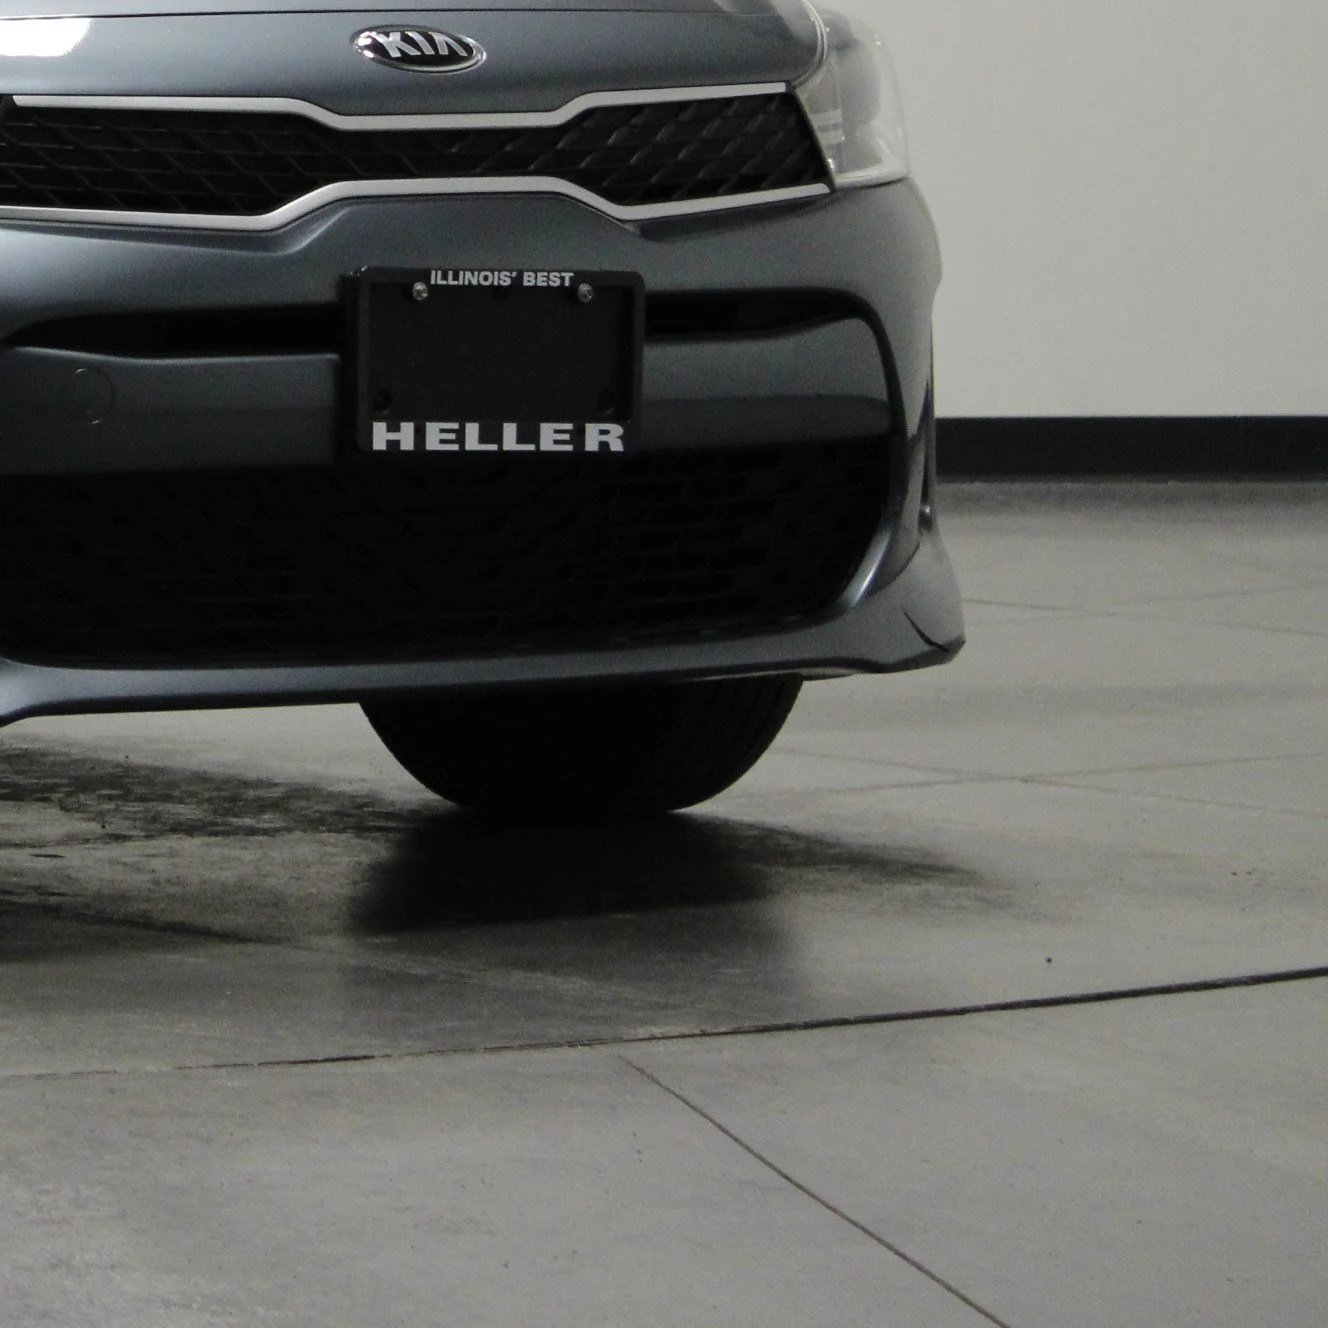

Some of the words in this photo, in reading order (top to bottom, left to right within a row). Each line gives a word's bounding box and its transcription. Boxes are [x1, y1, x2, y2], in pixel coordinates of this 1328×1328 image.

[369, 30, 469, 58] KIA
[522, 271, 574, 287] BEST
[372, 422, 625, 452] HELLER
